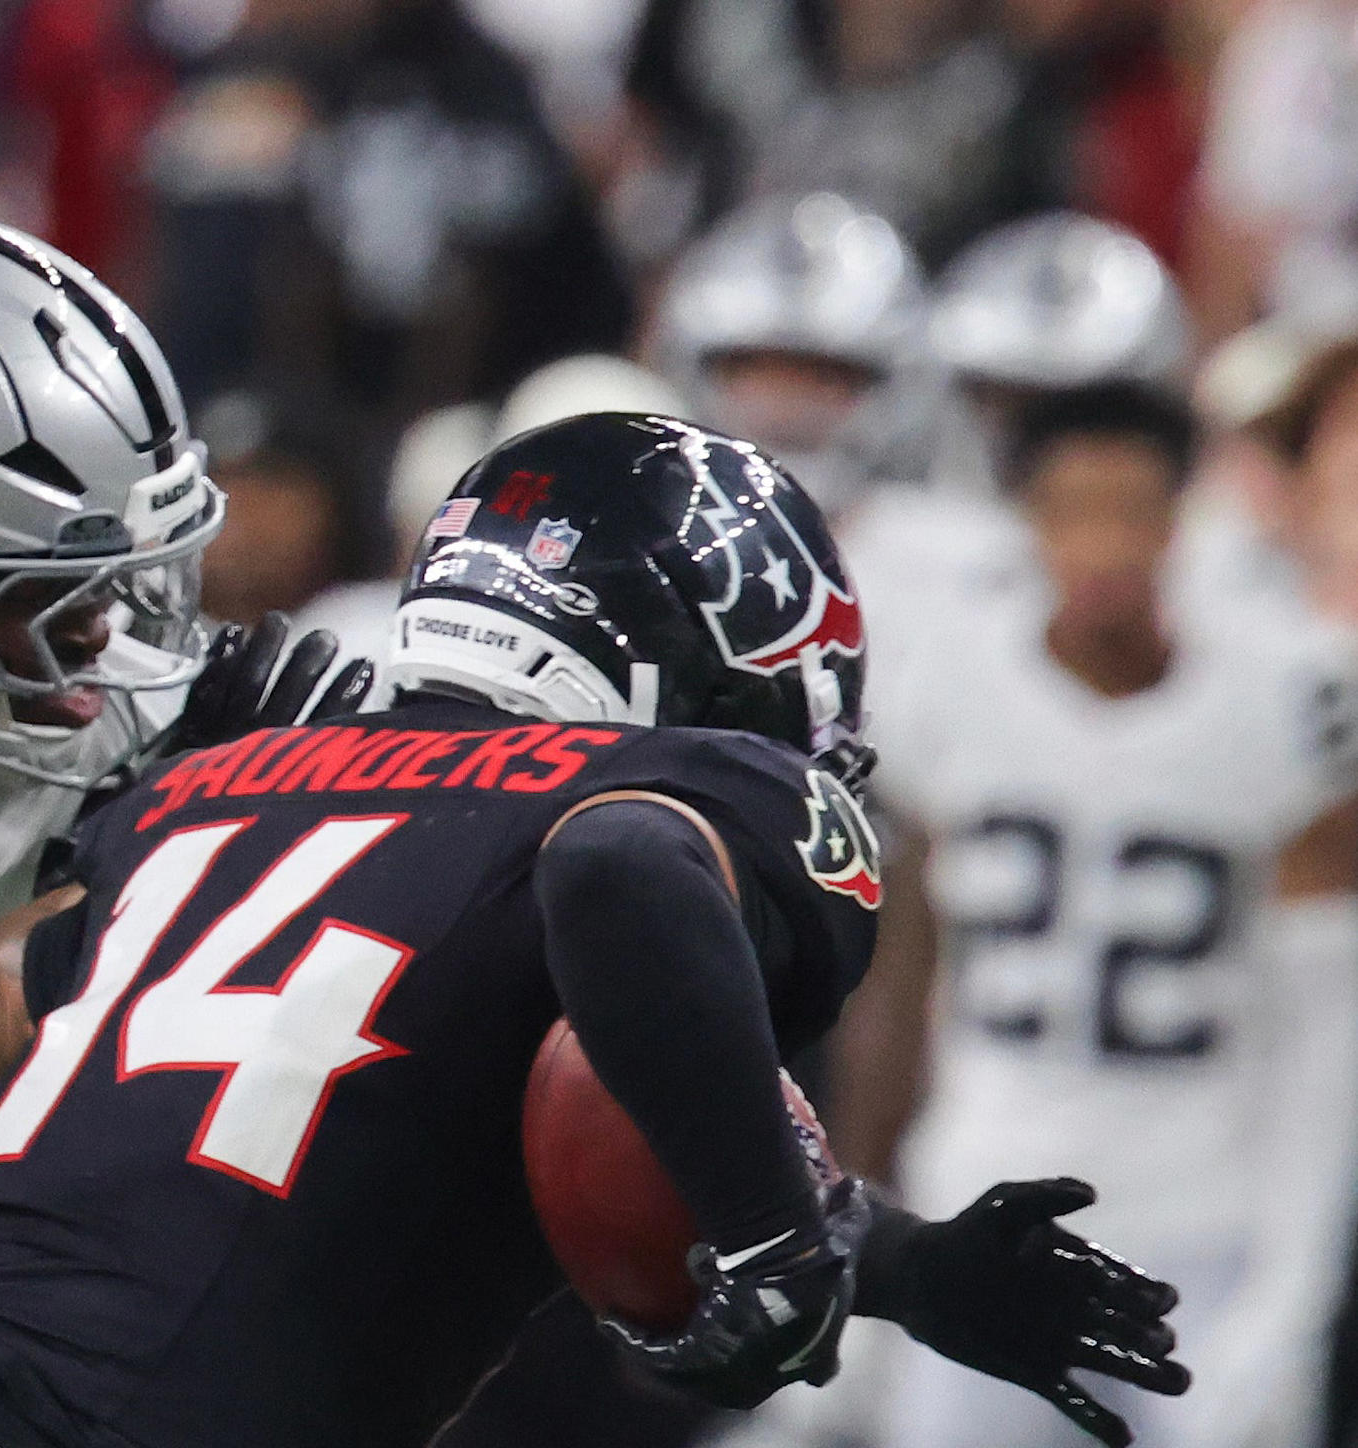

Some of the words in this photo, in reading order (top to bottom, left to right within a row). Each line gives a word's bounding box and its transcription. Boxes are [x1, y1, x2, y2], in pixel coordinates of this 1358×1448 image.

[415, 617, 470, 640] CHOOSE
[474, 627, 521, 651] LOVE
[135, 722, 621, 832] SAUNDERS
